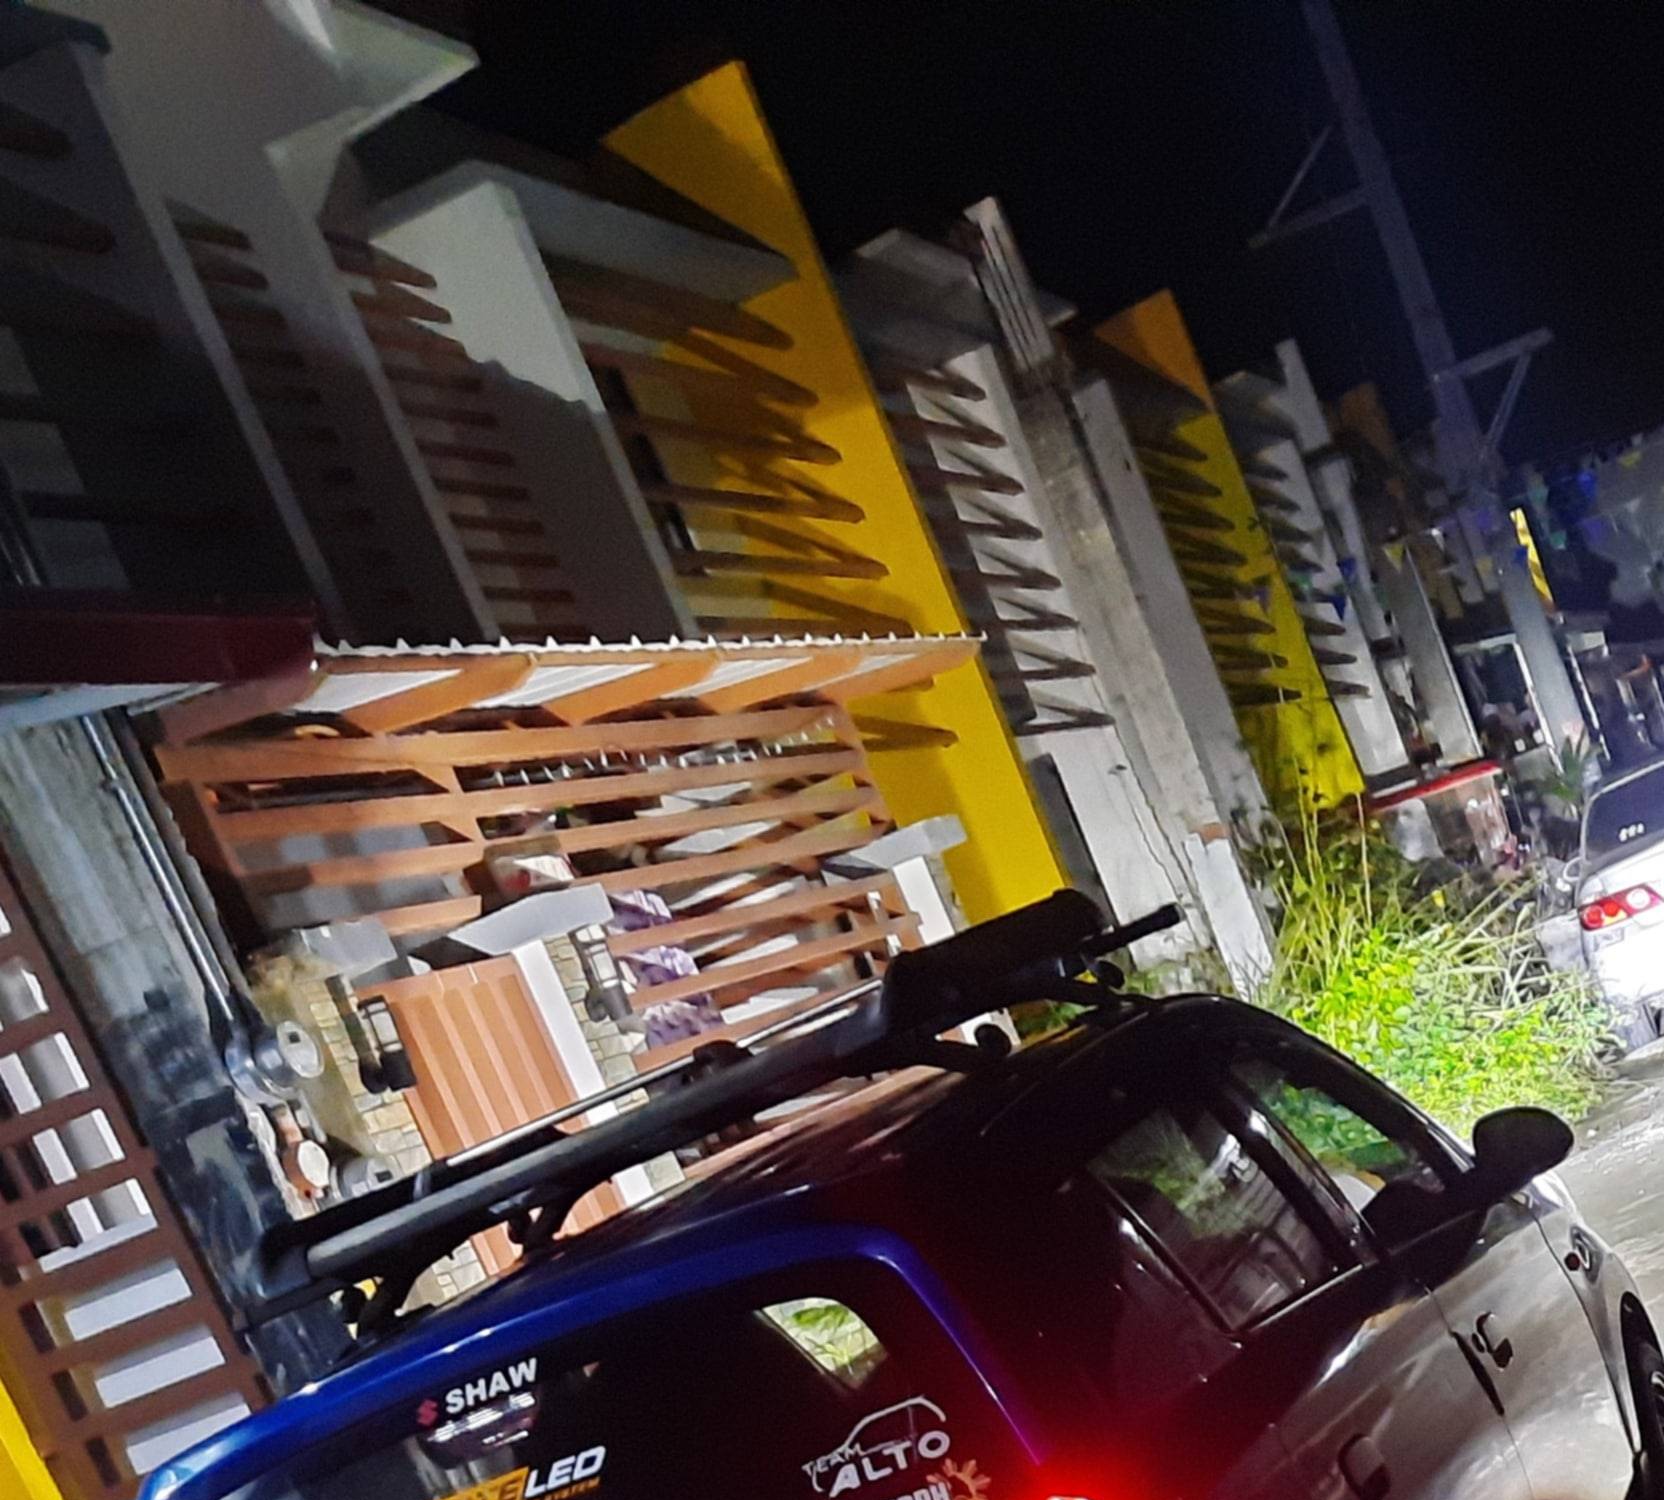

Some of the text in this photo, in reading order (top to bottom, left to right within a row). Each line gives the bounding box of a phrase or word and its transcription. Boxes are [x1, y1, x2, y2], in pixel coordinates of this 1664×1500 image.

[445, 1357, 538, 1414] SHAW
[802, 1443, 864, 1476] TEAM
[829, 1430, 950, 1497] ALTO
